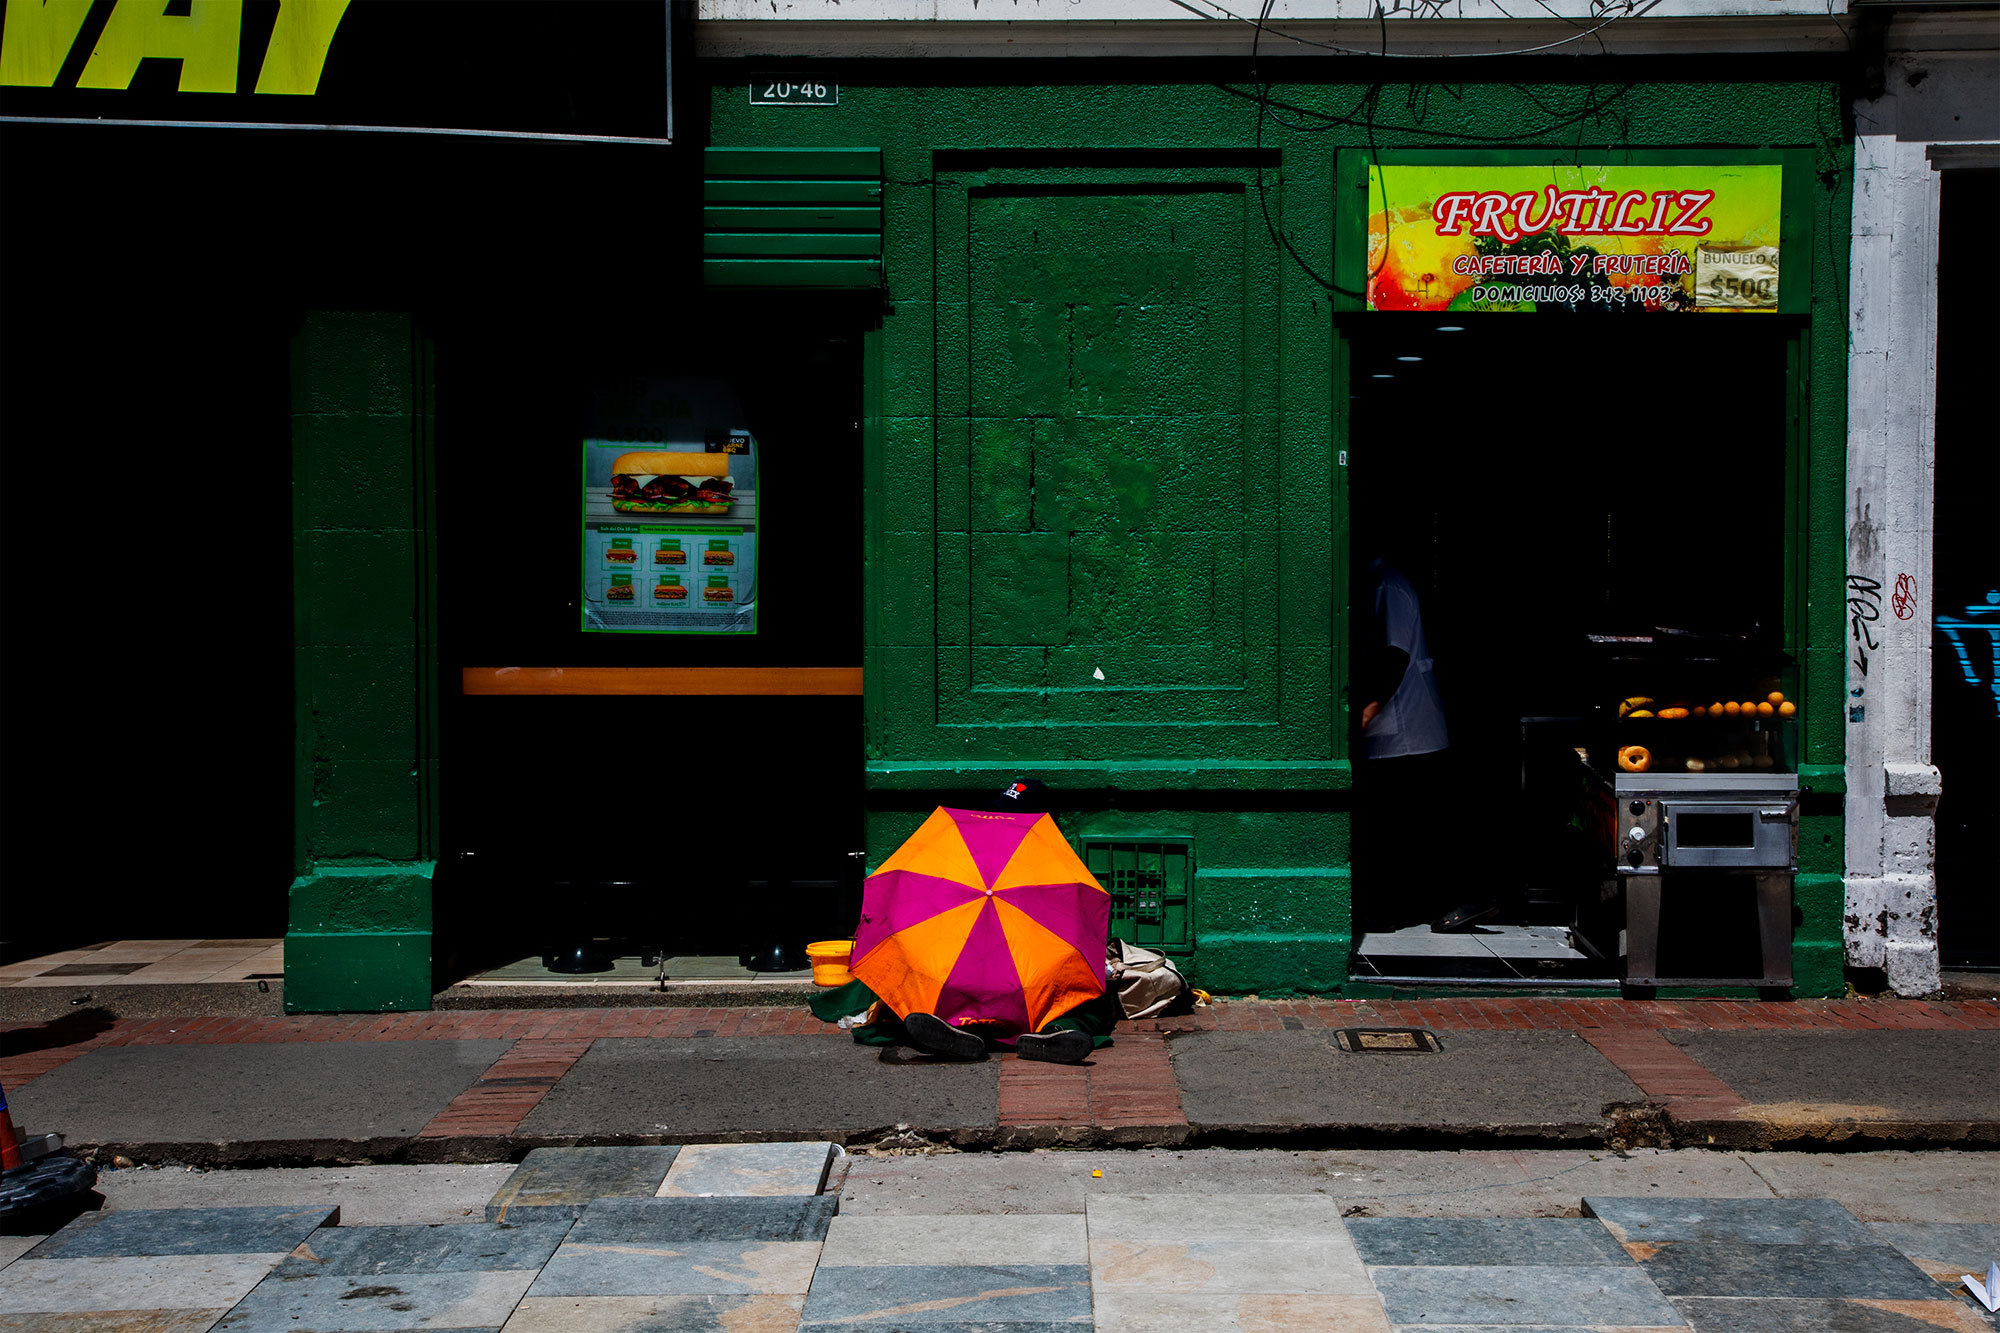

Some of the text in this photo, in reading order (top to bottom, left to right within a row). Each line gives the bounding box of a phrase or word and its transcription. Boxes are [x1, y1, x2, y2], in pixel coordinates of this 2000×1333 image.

[763, 80, 827, 98] 20-46
[1434, 185, 1714, 243] FRUTILIZ
[1453, 250, 1692, 275] CAFETERÍA Y FRUTERÍA
[1473, 284, 1670, 302] DOMICILIOS: 342 1103
[1710, 275, 1772, 300] $500
